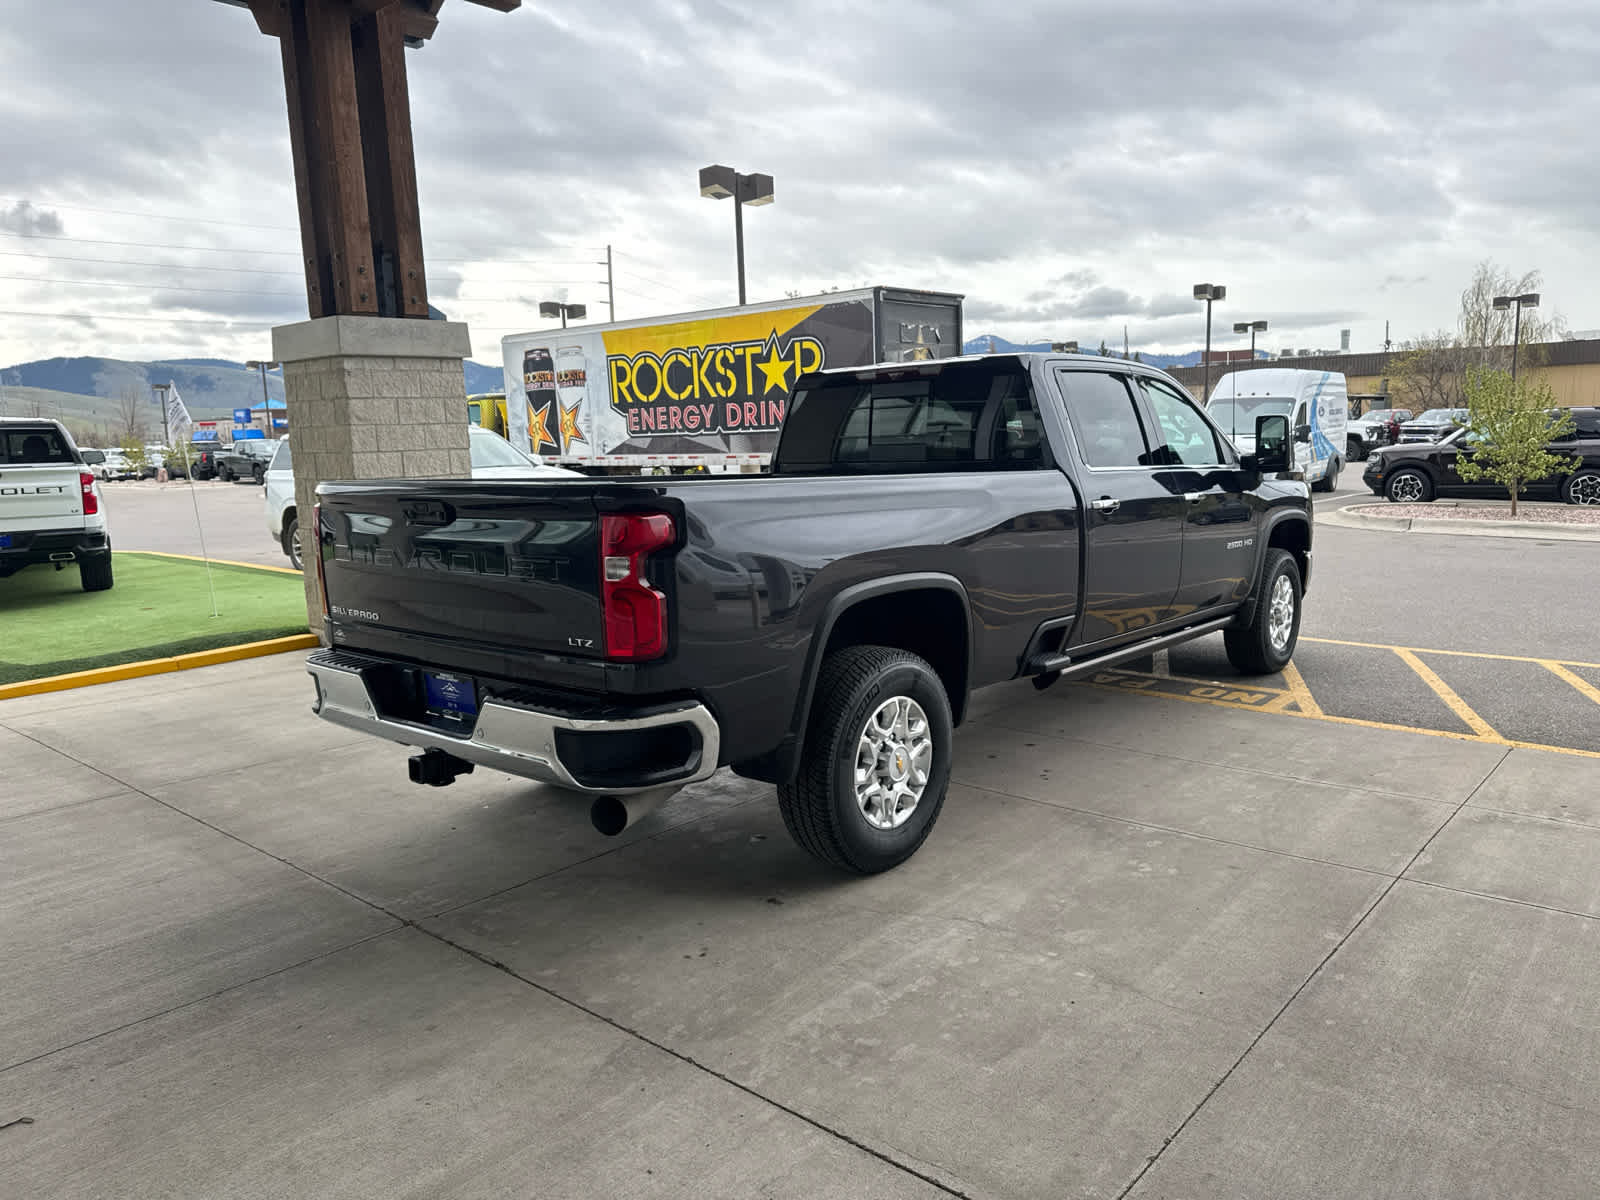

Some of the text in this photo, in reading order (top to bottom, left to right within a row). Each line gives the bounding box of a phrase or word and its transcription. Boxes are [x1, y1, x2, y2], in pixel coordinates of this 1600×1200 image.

[628, 400, 785, 431] ENERGY DRIN
[0, 486, 69, 496] OLET
[331, 605, 380, 621] SILVERADO
[568, 636, 594, 648] LTZ
[1189, 687, 1266, 704] NO
